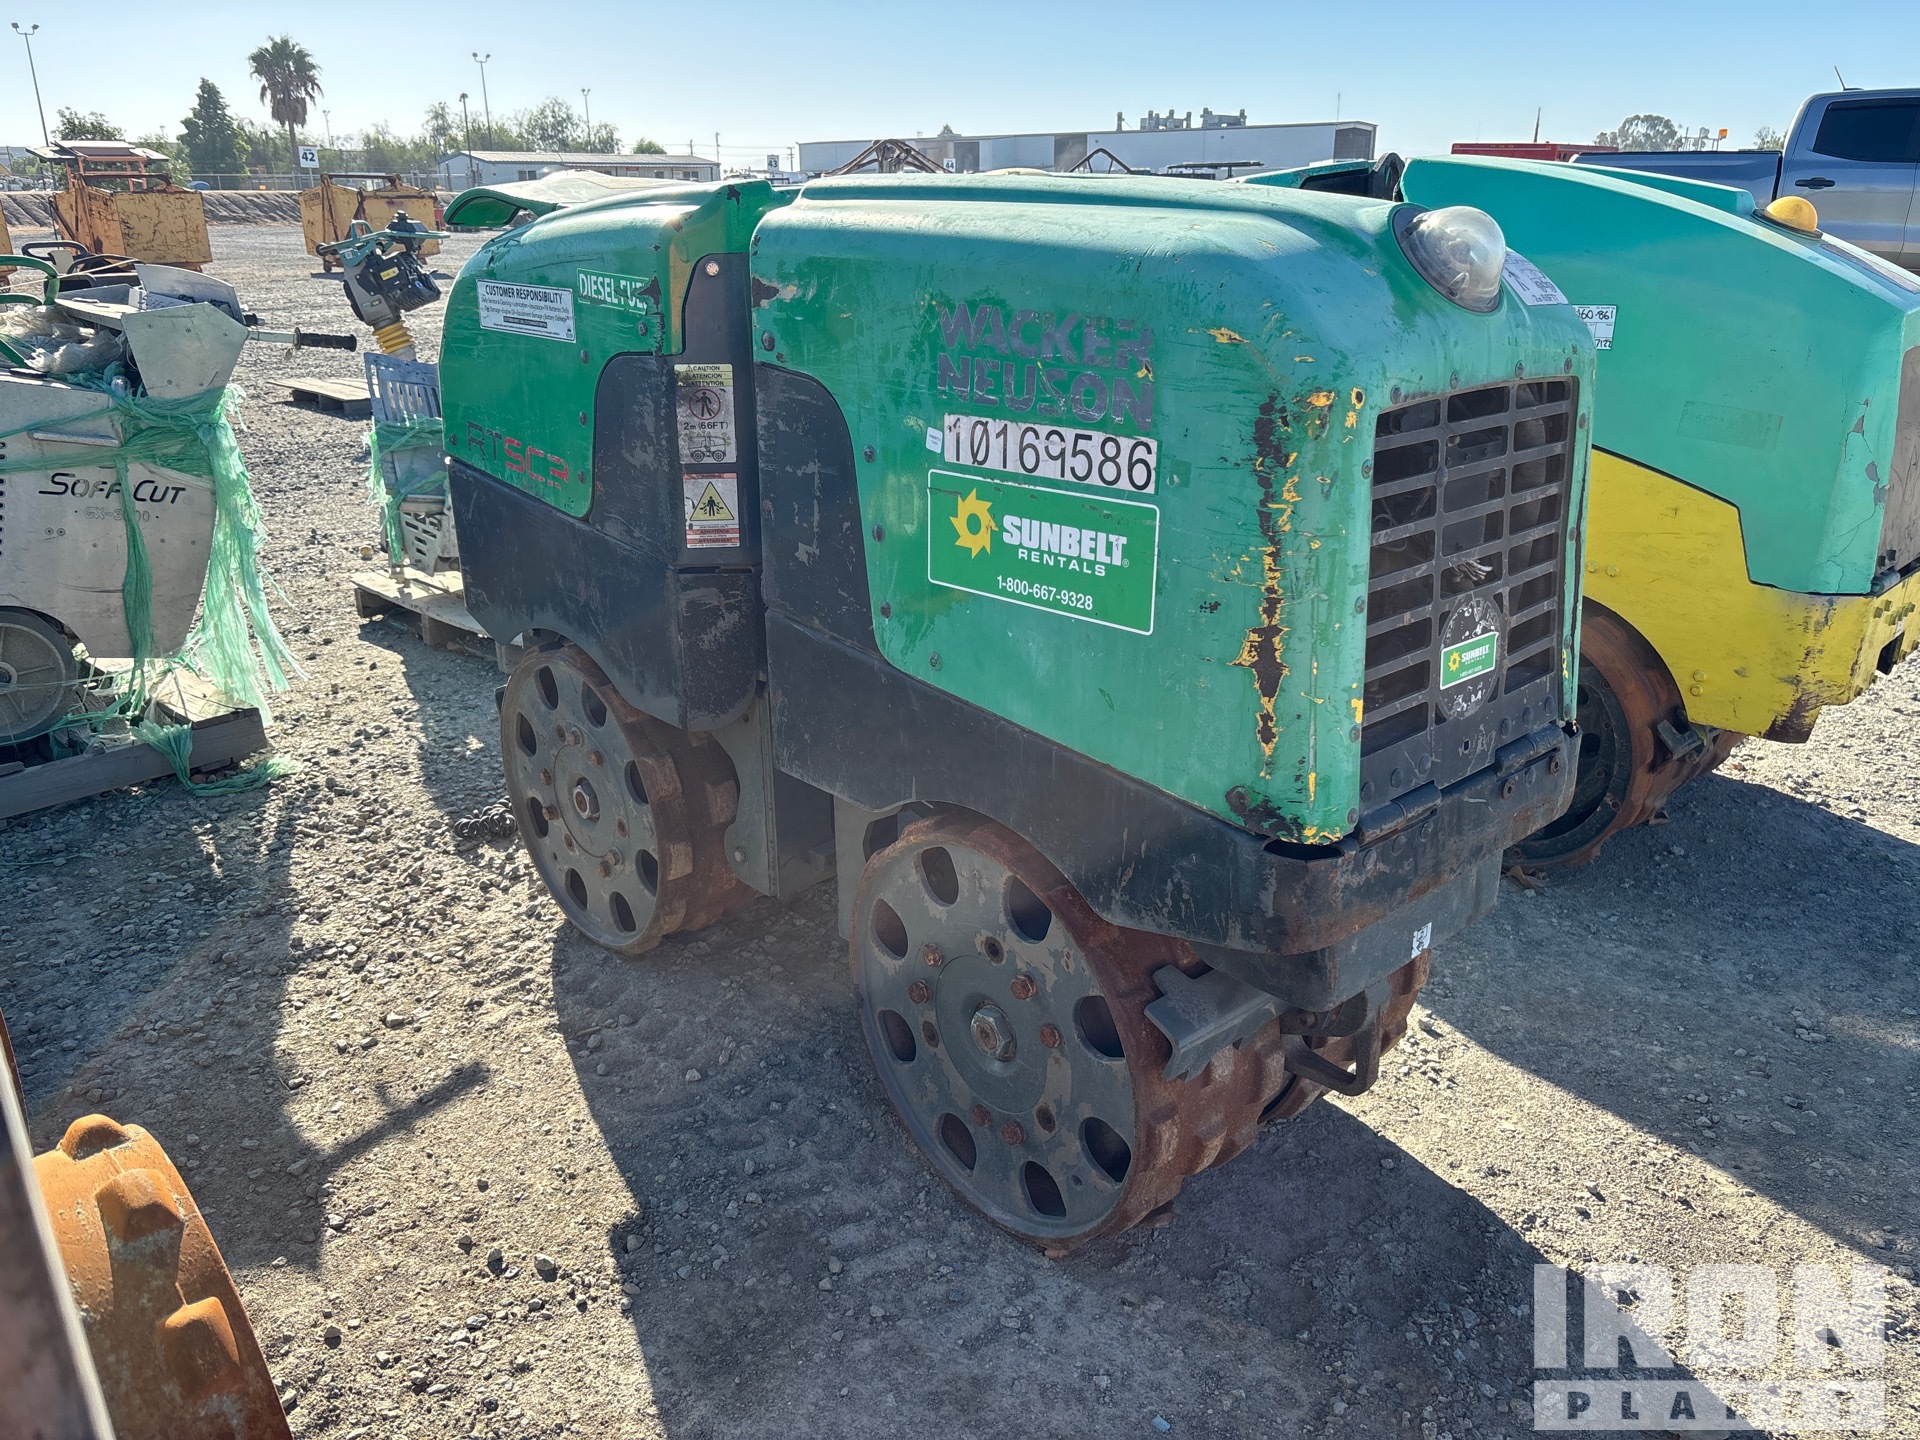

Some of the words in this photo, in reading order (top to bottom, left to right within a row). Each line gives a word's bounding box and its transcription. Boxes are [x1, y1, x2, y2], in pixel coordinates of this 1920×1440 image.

[301, 151, 316, 162] 42
[768, 160, 778, 168] 43
[485, 284, 516, 299] CUSTOMER
[515, 288, 563, 304] RESPONSIBILITY
[579, 273, 618, 304] DIESEL
[936, 302, 1155, 371] WACKER
[937, 353, 1155, 431] NEUSON
[947, 417, 1153, 491] 10169586
[133, 479, 186, 504] CUT
[1002, 514, 1127, 566] SUNBELT
[1018, 548, 1106, 577] RENTALS
[996, 575, 1093, 610] 1-800-667-9328
[1461, 644, 1489, 663] SUNBELT
